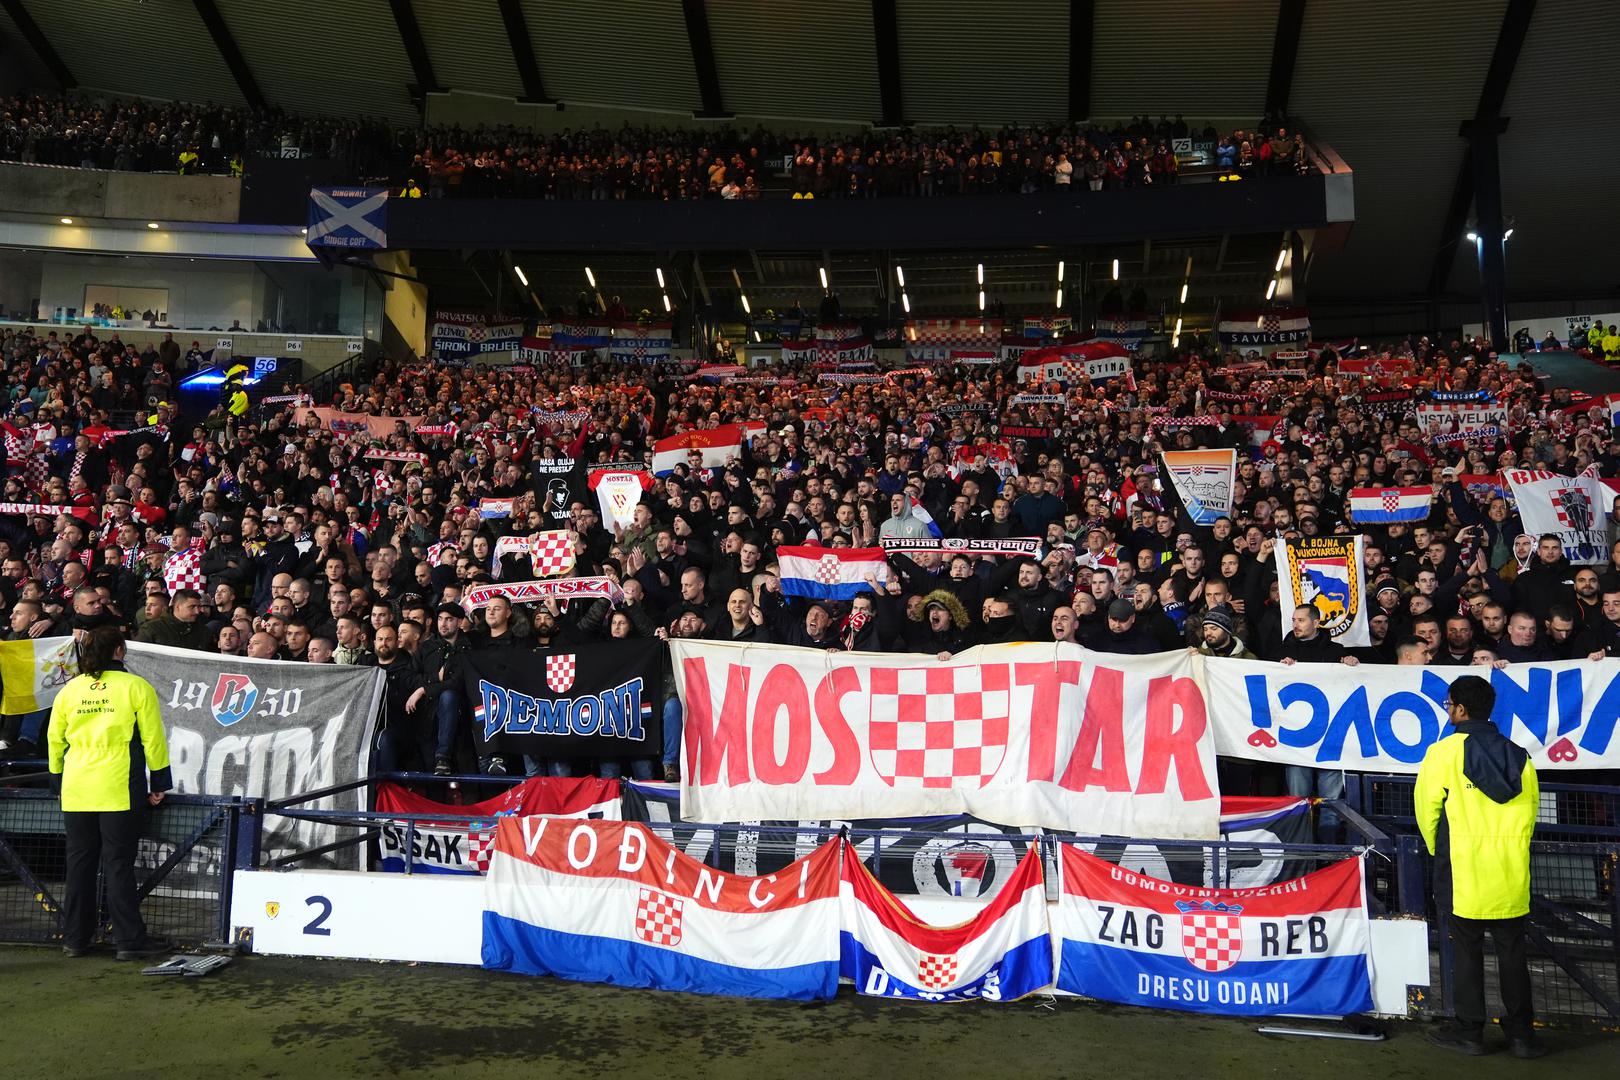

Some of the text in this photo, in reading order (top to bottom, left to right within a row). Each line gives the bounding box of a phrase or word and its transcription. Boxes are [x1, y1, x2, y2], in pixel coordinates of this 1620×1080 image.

[1174, 141, 1189, 151] 75
[283, 149, 298, 159] 73
[436, 311, 487, 322] HRVATSKA
[287, 342, 297, 350] P6
[352, 344, 362, 352] P6
[434, 338, 520, 353] ŠIROKI BRIJEG
[256, 359, 276, 371] 56
[0, 503, 73, 514] HRVATSKA
[885, 538, 1036, 552] Tribina Stajanje
[1310, 538, 1340, 548] BOJNA
[1295, 546, 1346, 559] VUKOVARSKA
[469, 580, 610, 605] HRVATSKA
[77, 707, 102, 715] assist
[478, 676, 646, 744] DEMONI
[521, 817, 809, 910] VOĐINCI
[303, 895, 332, 936] 2
[1136, 973, 1289, 1006] DRESU ODANI
